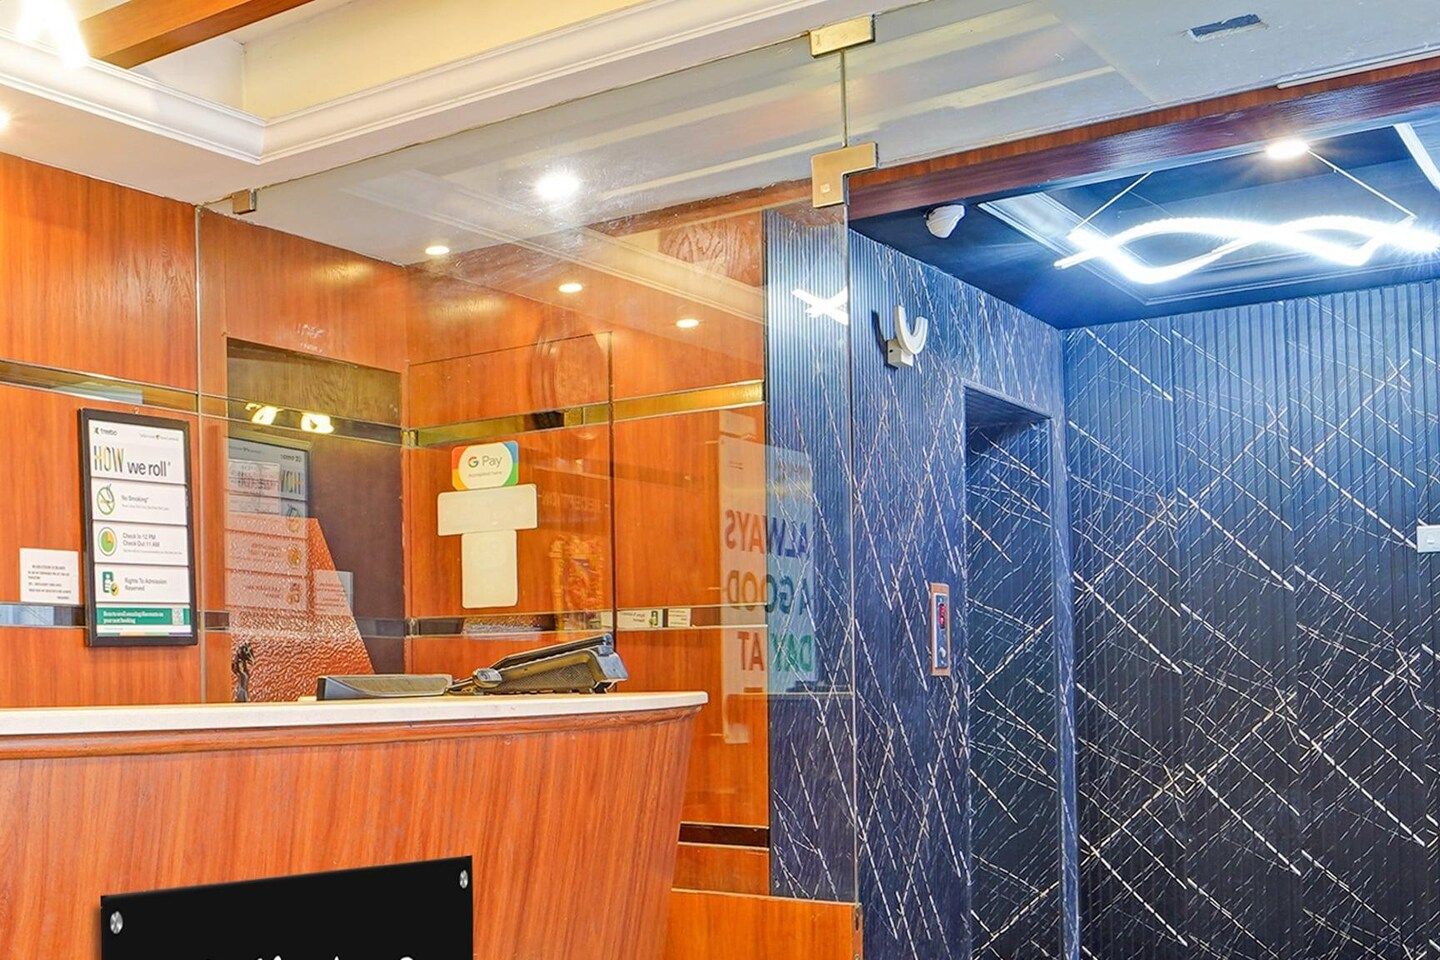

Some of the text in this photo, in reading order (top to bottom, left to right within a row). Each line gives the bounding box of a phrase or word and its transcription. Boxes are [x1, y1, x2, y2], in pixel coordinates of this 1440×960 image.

[93, 445, 124, 473] HOW
[127, 461, 146, 476] we
[482, 455, 503, 468] Pay
